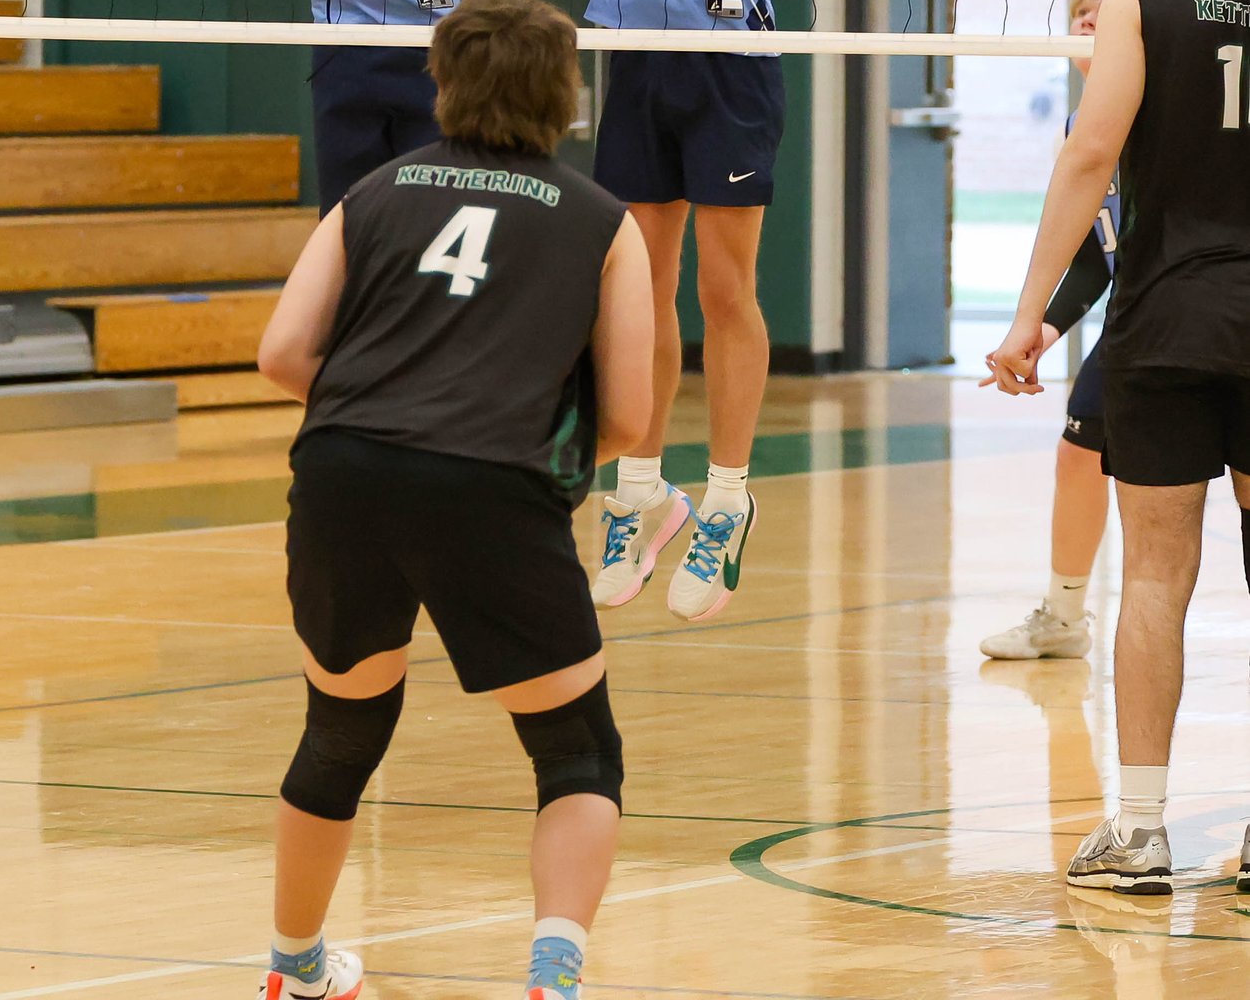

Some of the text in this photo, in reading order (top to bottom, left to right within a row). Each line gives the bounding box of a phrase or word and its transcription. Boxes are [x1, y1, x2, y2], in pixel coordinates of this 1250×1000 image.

[1216, 44, 1250, 130] 1
[395, 163, 562, 208] KETTERING
[417, 204, 498, 297] 4
